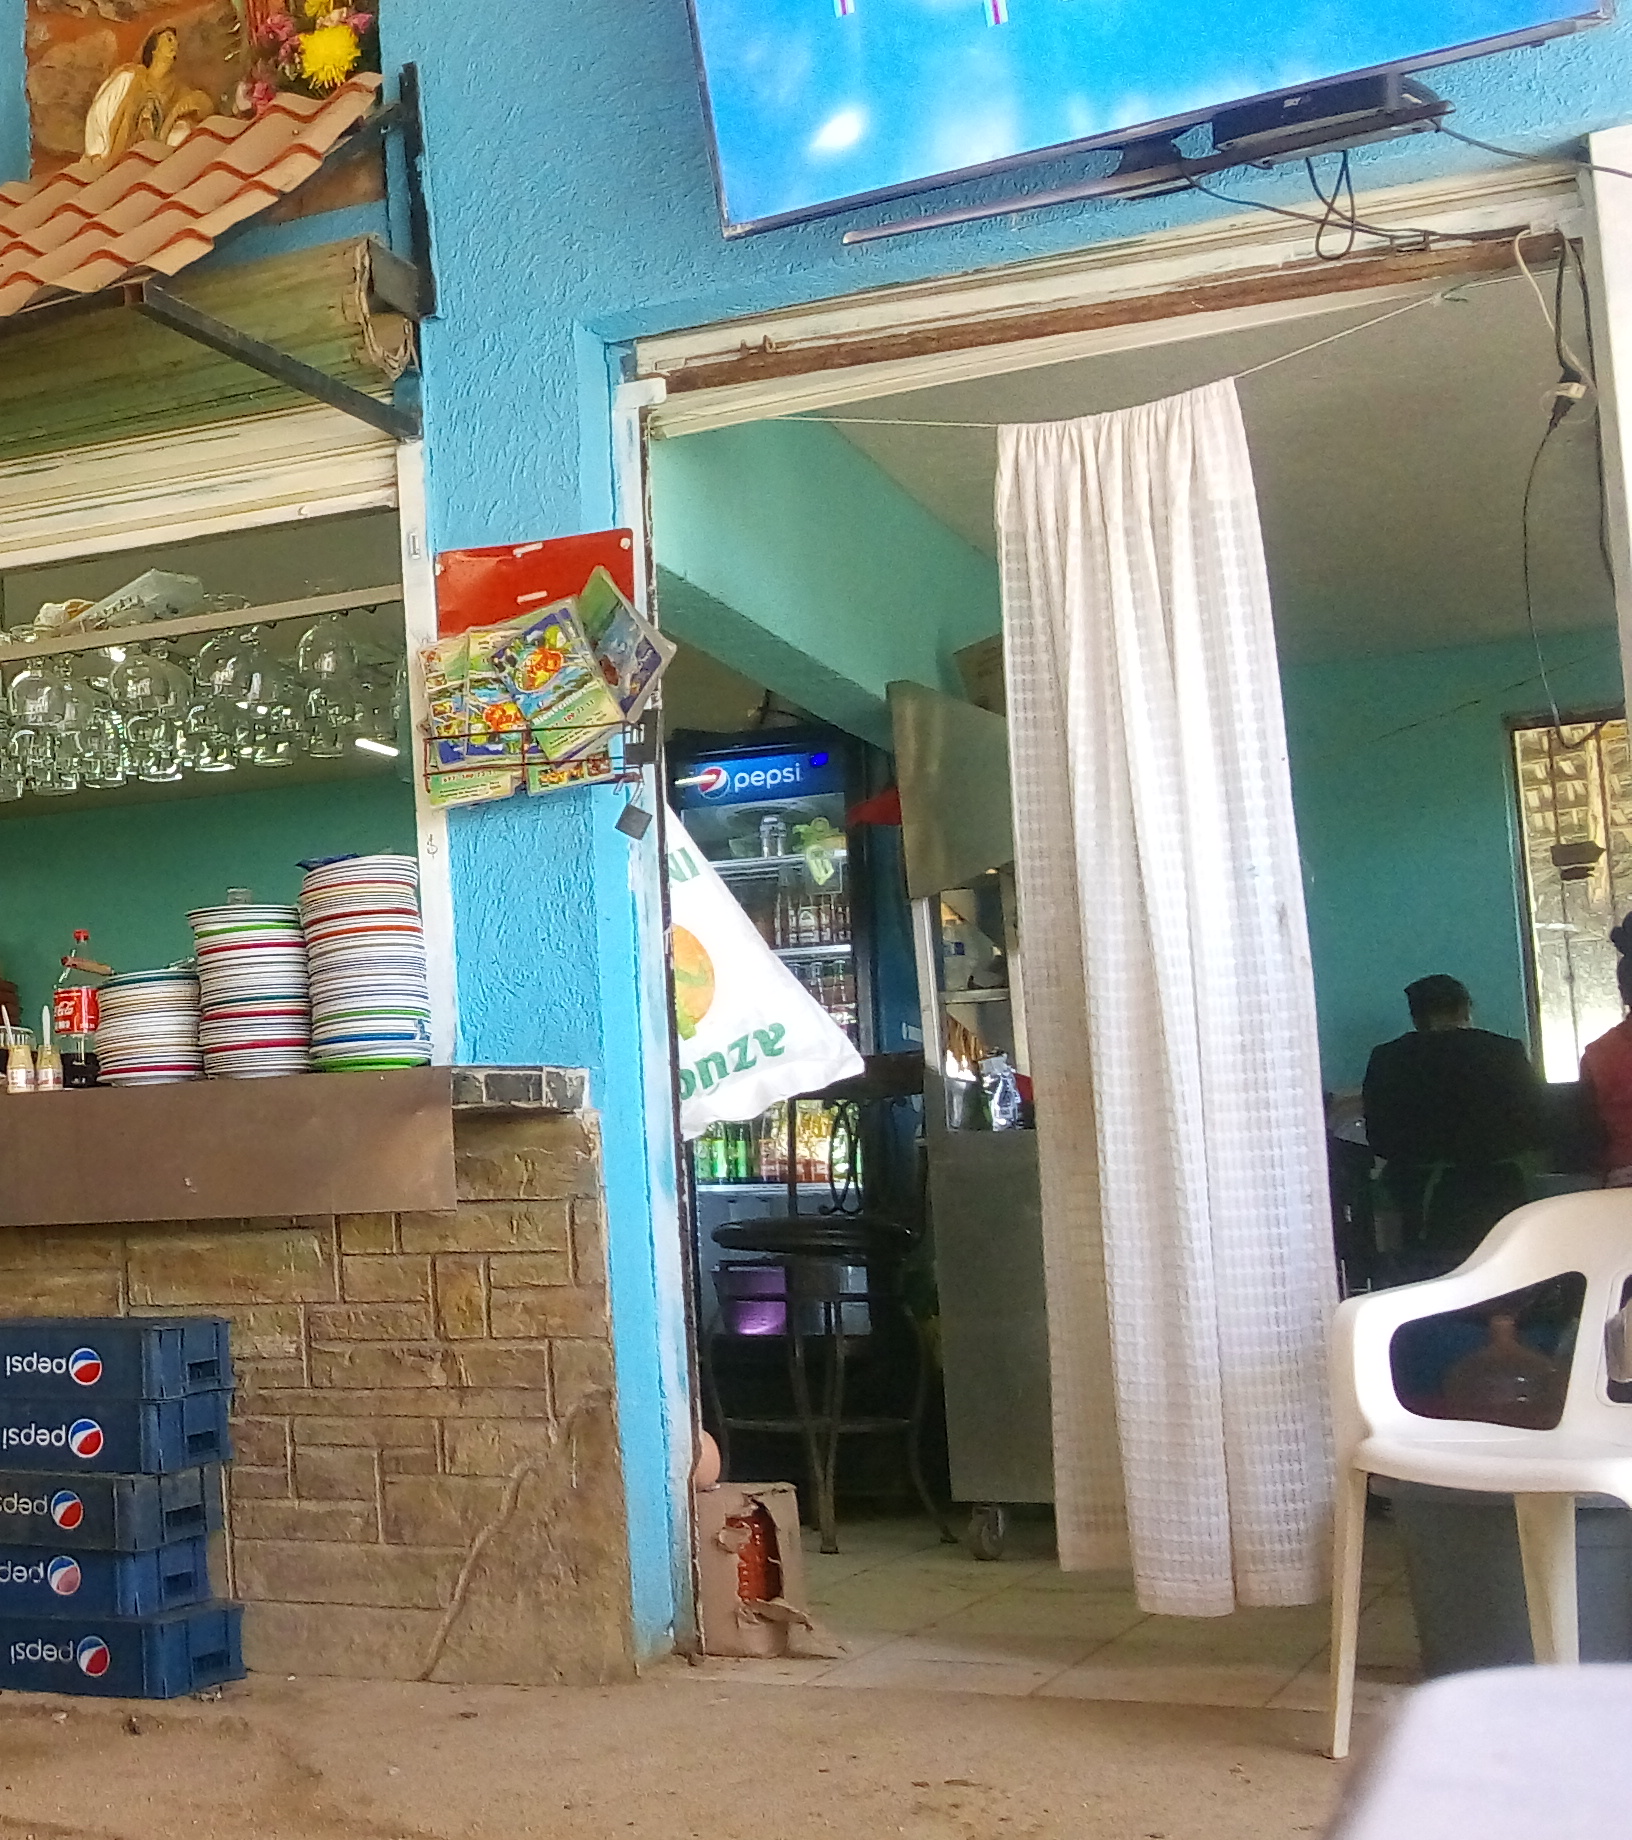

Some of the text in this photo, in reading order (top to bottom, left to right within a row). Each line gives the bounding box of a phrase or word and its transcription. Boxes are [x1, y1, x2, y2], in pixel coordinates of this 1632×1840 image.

[734, 762, 801, 793] pepsi
[6, 1351, 67, 1377] pepsi
[2, 1423, 66, 1450] pepsi
[10, 1638, 74, 1665] pepsi
